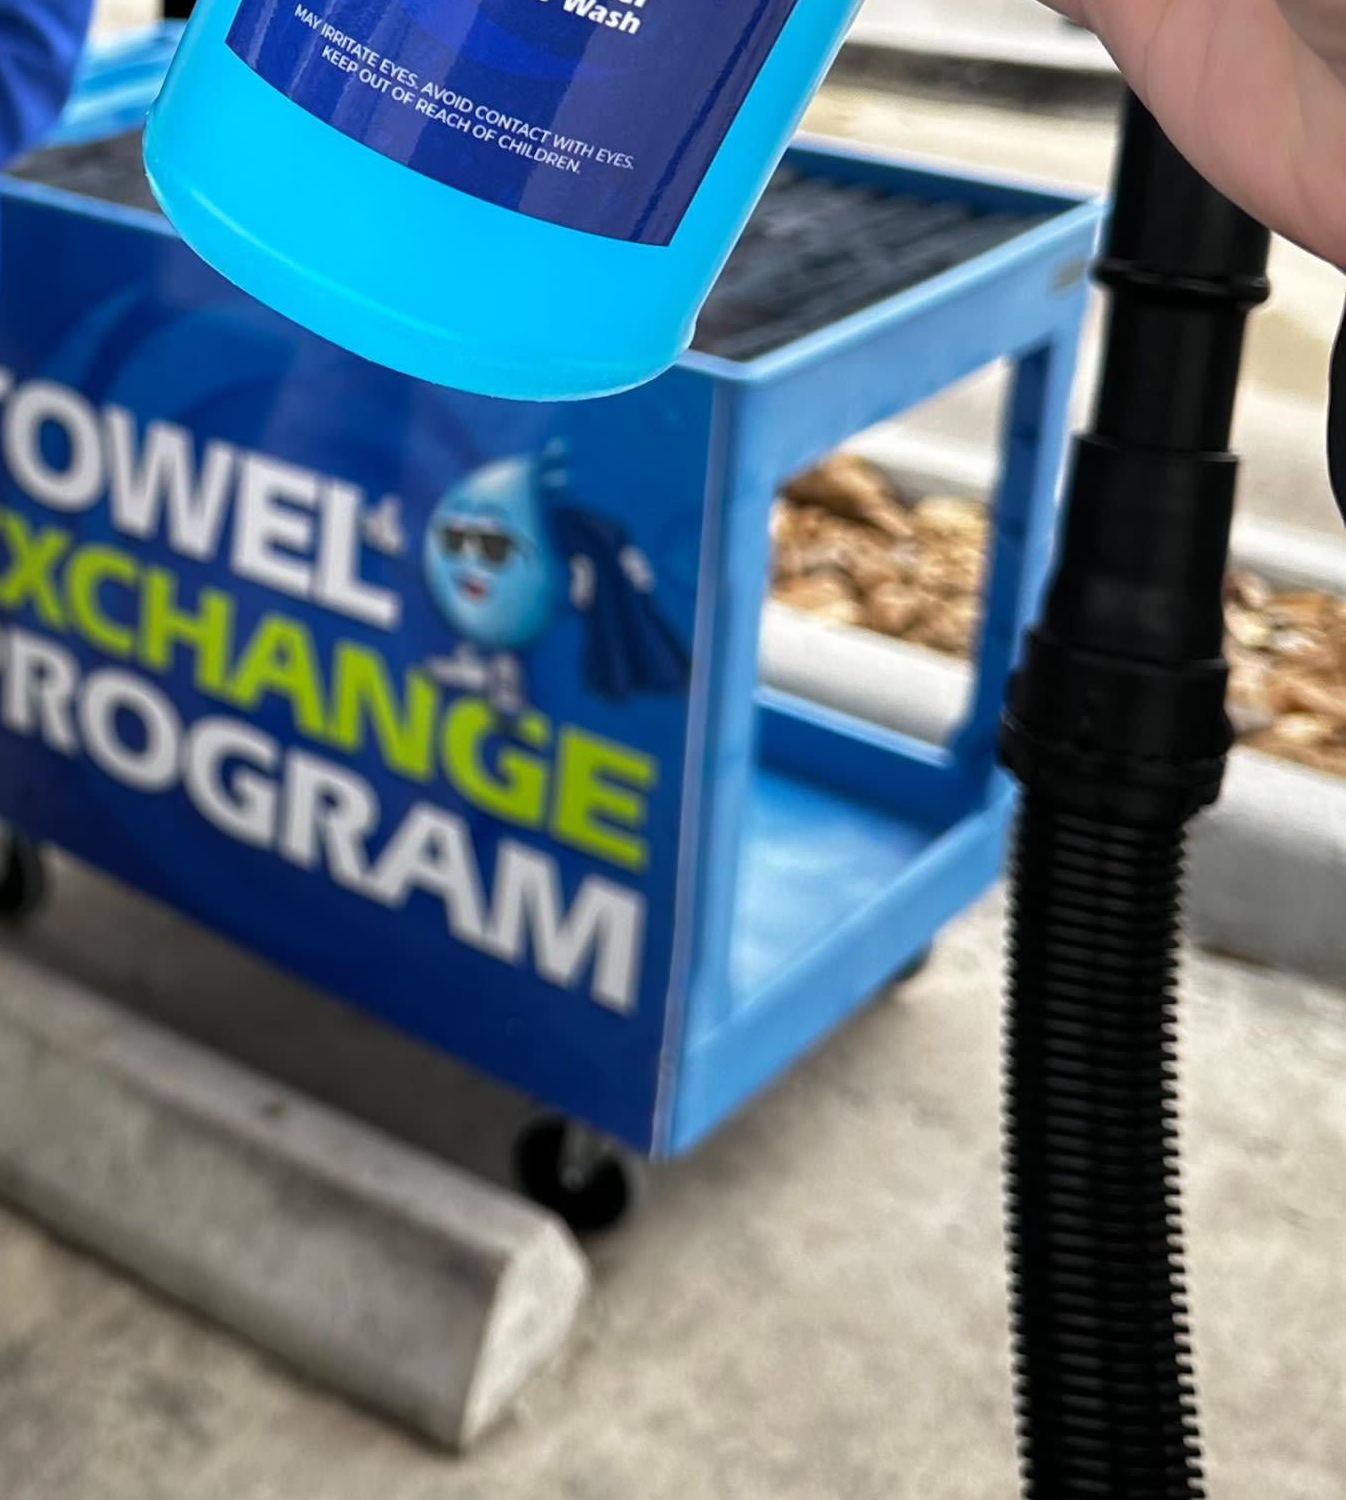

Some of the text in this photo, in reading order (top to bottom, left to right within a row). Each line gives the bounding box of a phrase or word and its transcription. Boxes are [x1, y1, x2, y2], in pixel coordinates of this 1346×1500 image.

[294, 4, 635, 170] MAY IRRITATE EYES. AVOID CONTACT WITH EYES.
[321, 45, 581, 175] KEEP OUT OF REACH OF CHILDREN.
